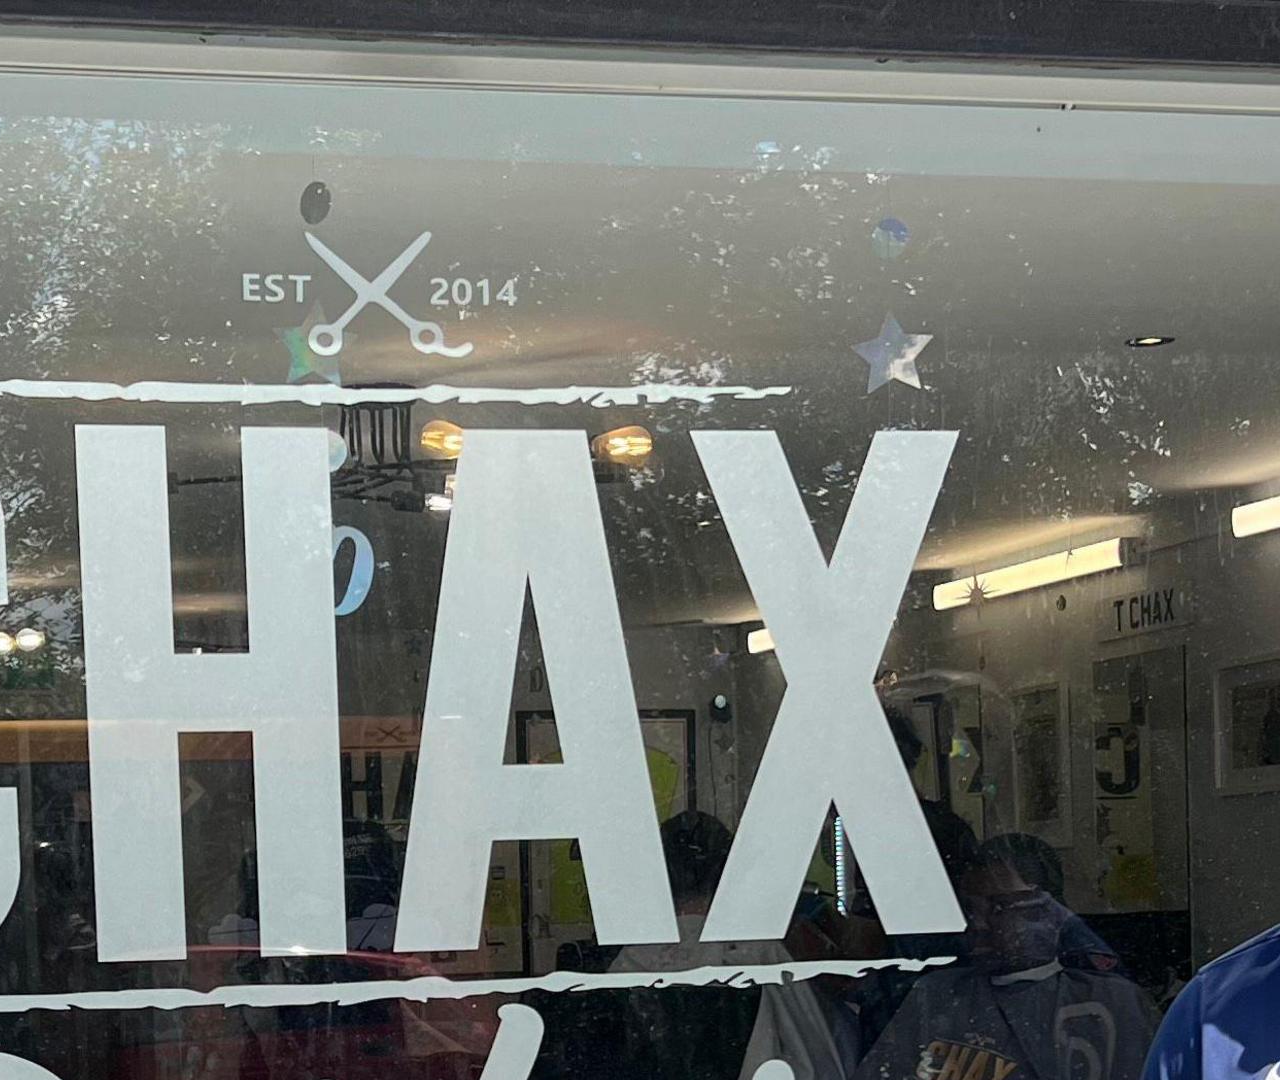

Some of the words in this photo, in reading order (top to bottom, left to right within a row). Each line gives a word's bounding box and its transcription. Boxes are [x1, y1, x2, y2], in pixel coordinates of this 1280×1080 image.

[242, 273, 312, 302] EST
[429, 277, 518, 306] 2014
[1129, 588, 1174, 629] CHAX
